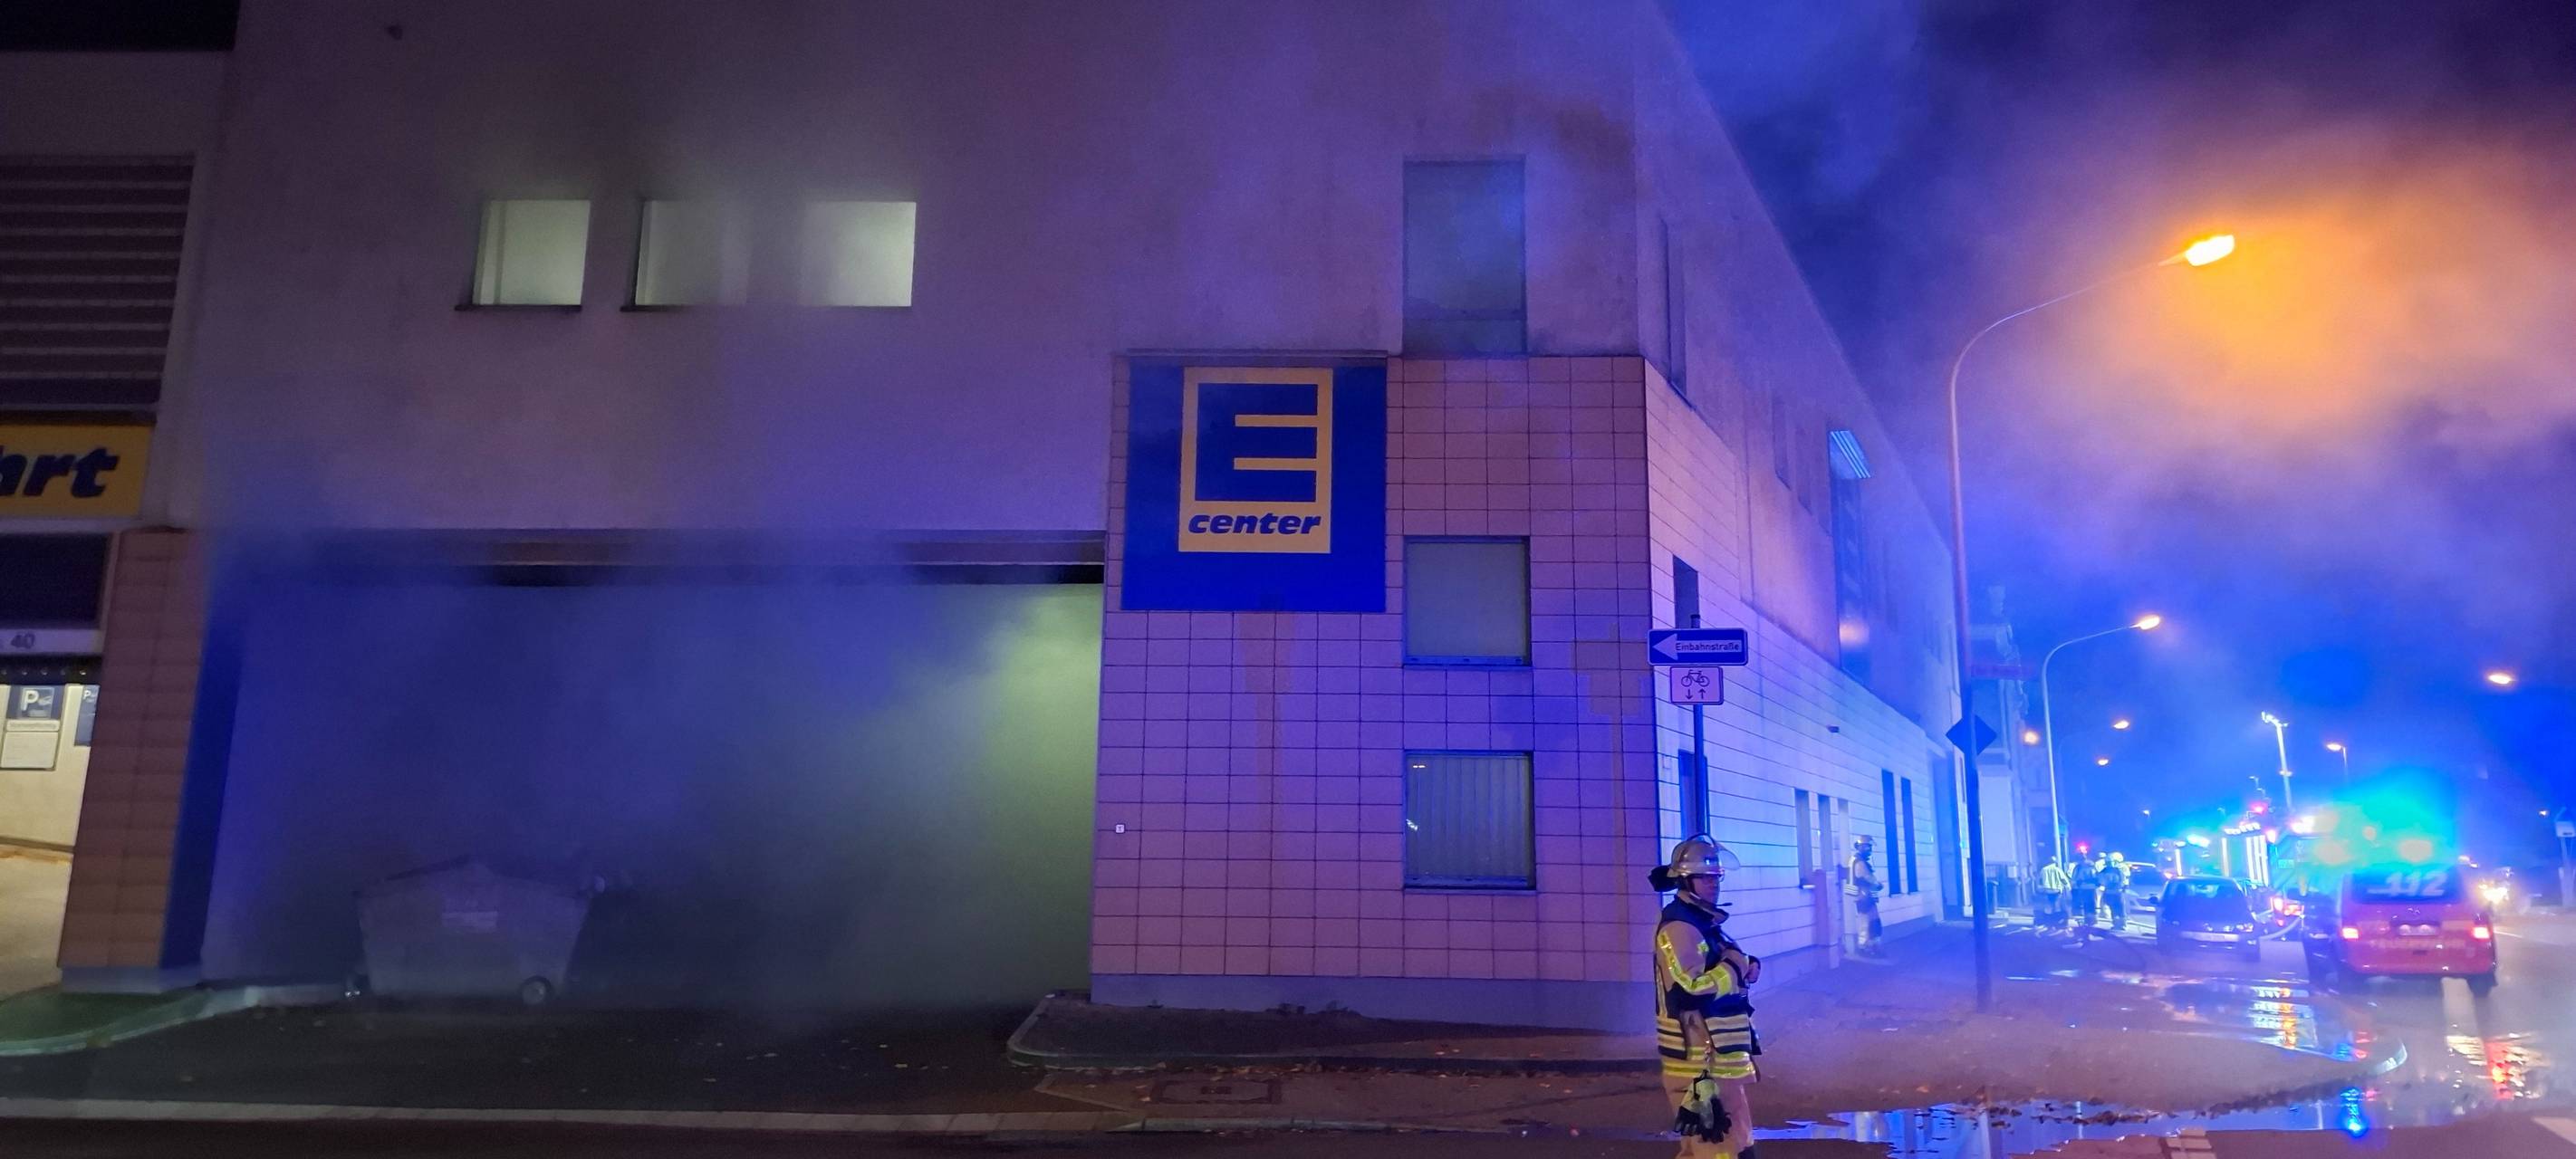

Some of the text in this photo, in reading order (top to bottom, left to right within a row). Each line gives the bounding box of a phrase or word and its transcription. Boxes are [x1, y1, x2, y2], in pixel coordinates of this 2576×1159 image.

[1195, 383, 1318, 503] E
[1188, 512, 1322, 534] center
[1675, 642, 1740, 651] Einbahnstraße
[20, 689, 39, 711] P
[2383, 870, 2447, 896] 112
